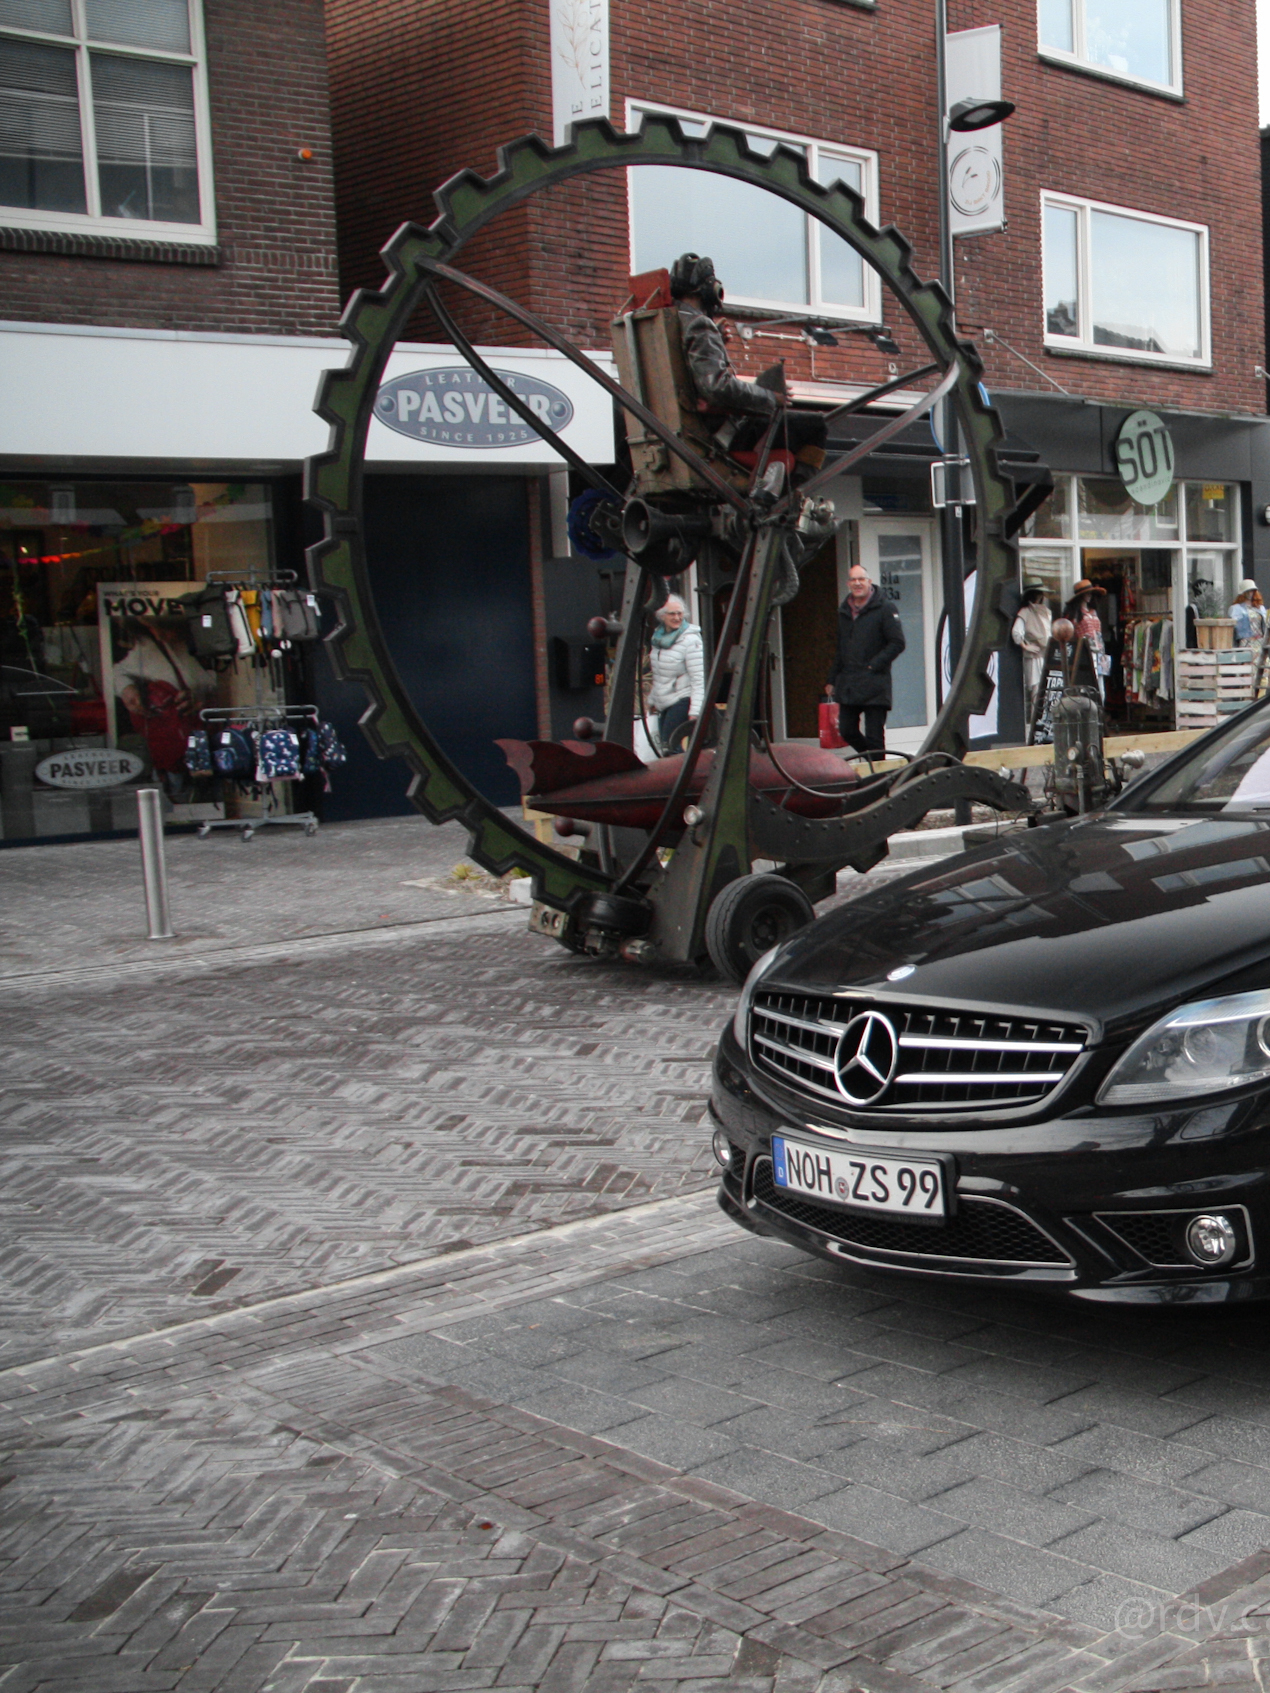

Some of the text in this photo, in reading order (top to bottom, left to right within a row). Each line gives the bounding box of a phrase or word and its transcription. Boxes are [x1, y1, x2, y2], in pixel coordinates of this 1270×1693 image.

[425, 373, 516, 388] LEATHR
[397, 389, 553, 425] PASVEER
[420, 426, 528, 442] SINCE 1925
[1115, 419, 1172, 487] SÖT
[103, 598, 184, 616] MOVE
[49, 758, 132, 778] PASVEER
[786, 1146, 833, 1194] NOH
[849, 1160, 890, 1203] ZS
[897, 1166, 939, 1209] 99
